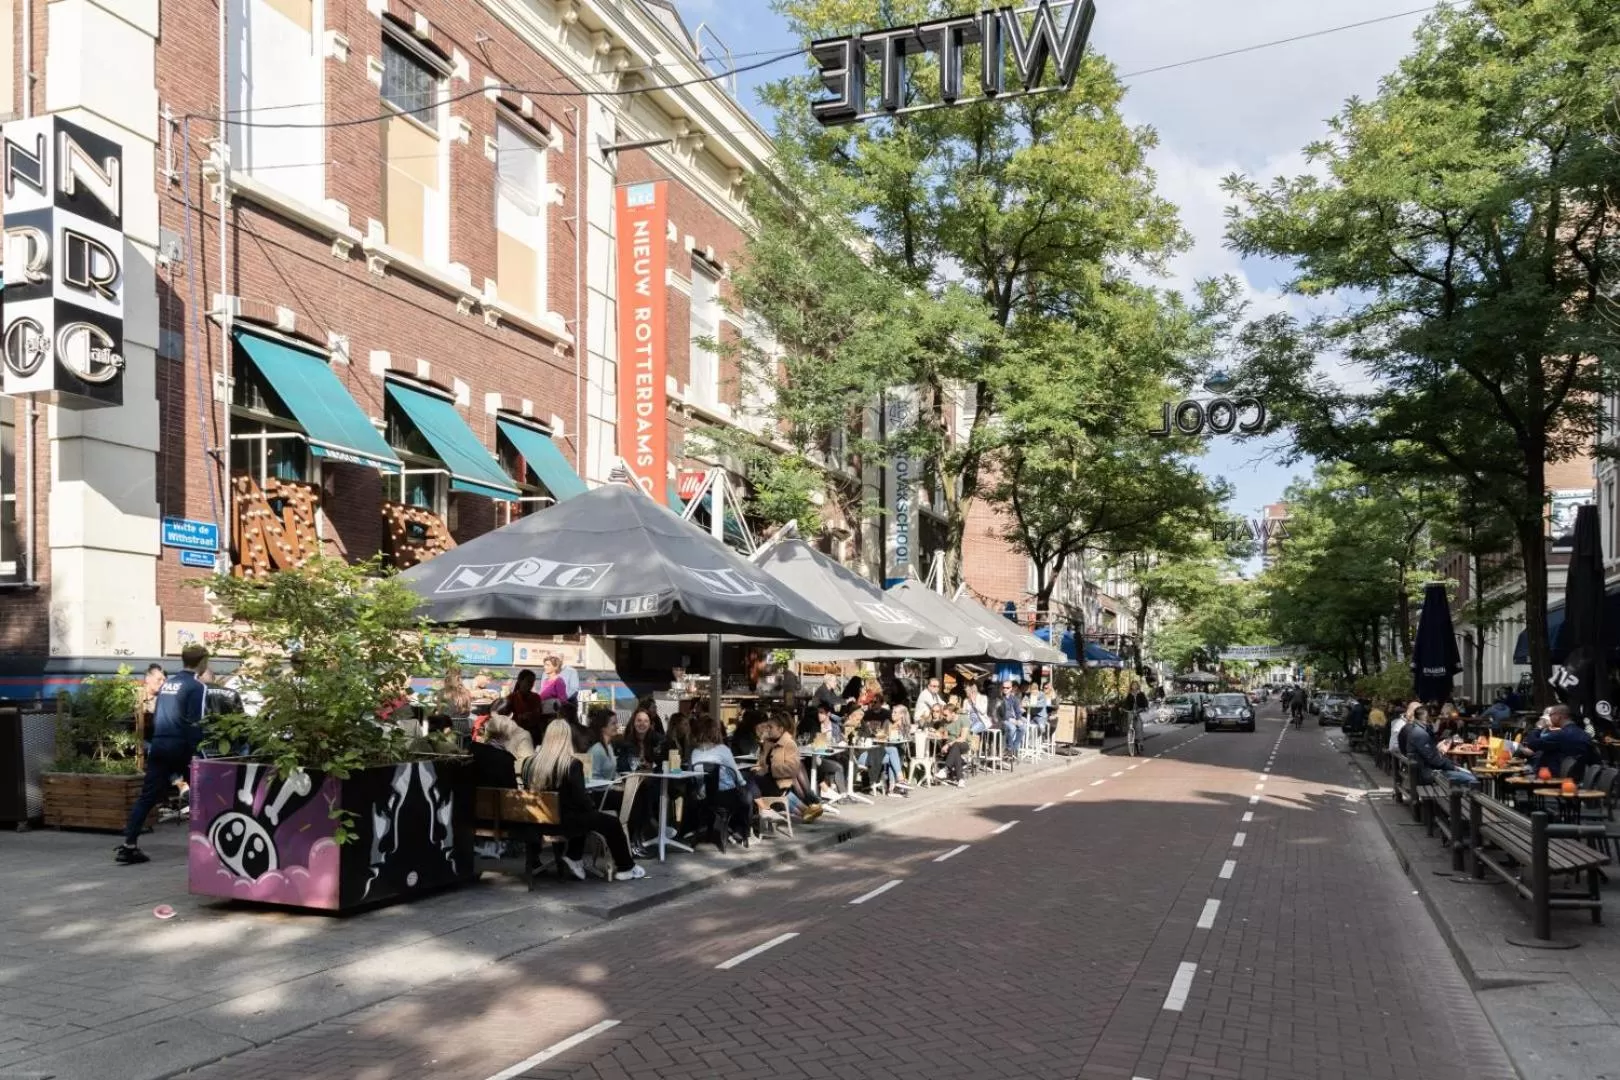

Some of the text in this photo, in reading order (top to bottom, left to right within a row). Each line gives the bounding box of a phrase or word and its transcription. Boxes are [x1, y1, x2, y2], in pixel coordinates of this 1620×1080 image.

[632, 220, 651, 296] NIEUW
[633, 307, 654, 466] ROTTERDAMS
[167, 532, 214, 546] Withstraat
[199, 526, 209, 535] de
